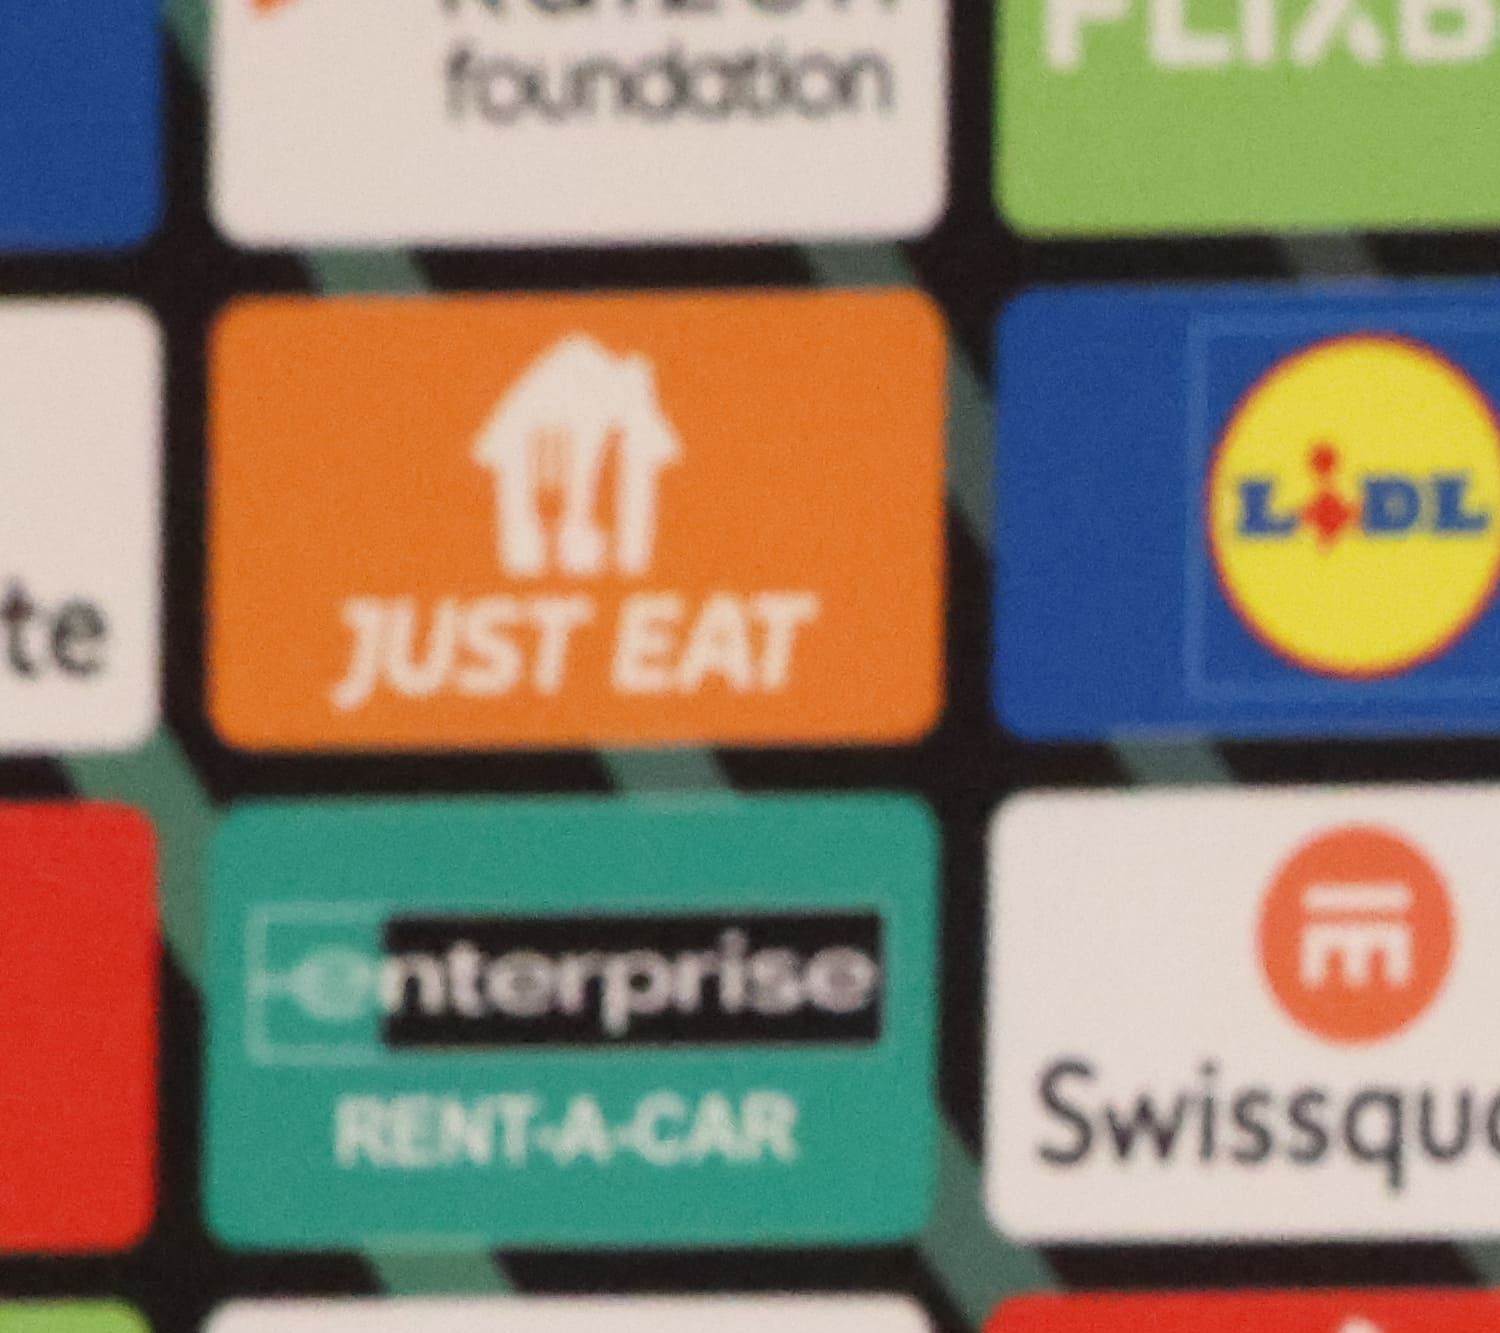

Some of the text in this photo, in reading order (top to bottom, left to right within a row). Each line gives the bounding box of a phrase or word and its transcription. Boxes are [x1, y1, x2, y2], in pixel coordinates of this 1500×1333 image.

[444, 42, 894, 126] foundation
[331, 588, 820, 712] JUST EAT
[292, 918, 885, 1036] enterprise
[335, 1090, 799, 1170] RENT-A-CAR
